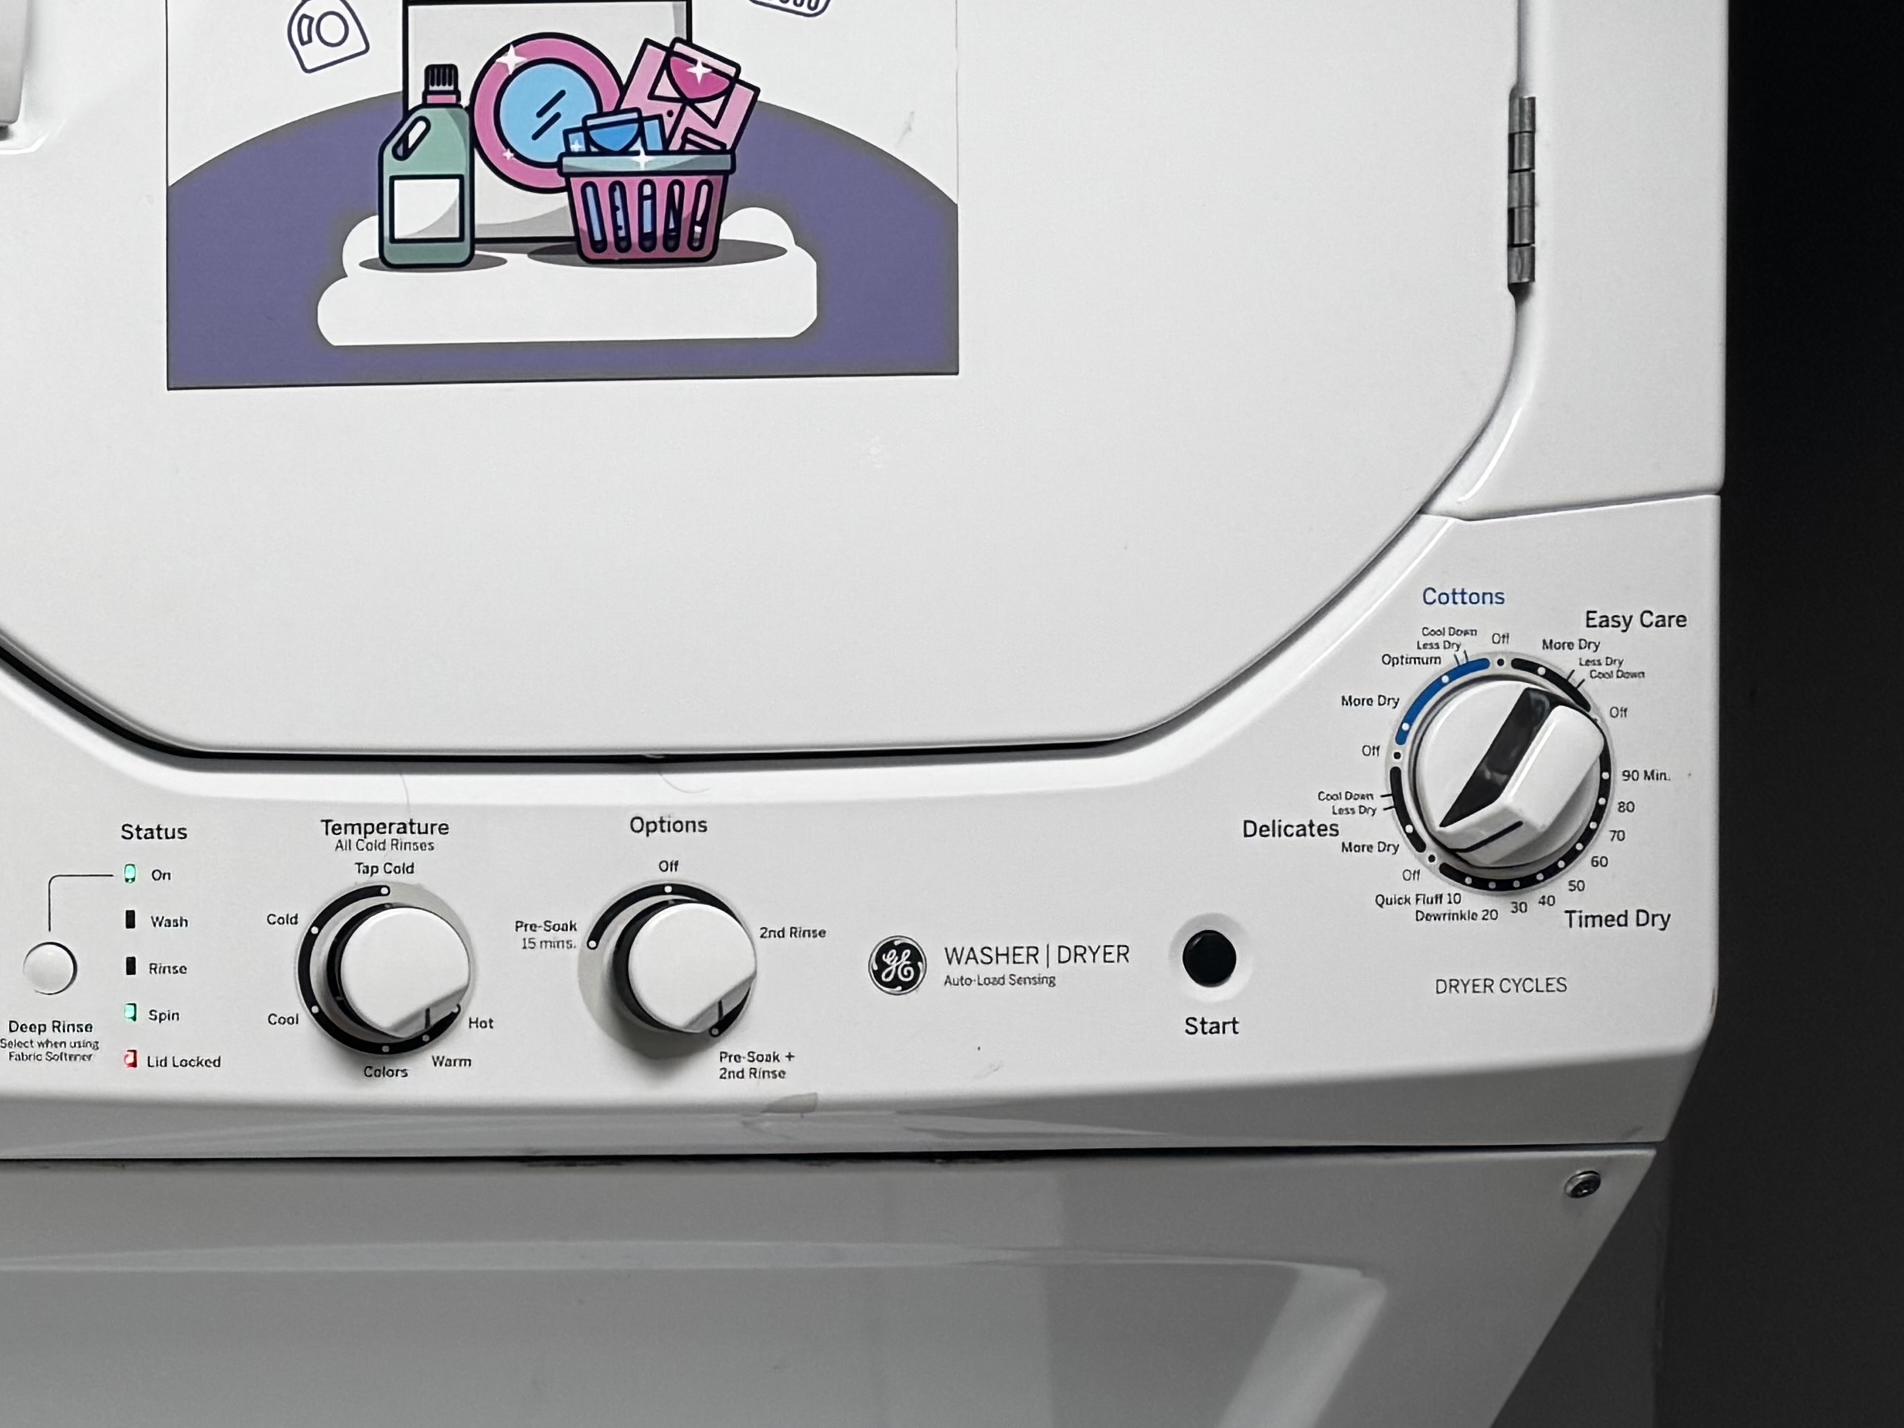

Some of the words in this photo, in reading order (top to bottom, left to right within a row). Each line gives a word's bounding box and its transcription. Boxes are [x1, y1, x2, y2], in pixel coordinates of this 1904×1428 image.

[1423, 587, 1505, 605] Cottons
[1586, 610, 1633, 633] Easy
[1640, 610, 1687, 628] Care
[121, 824, 187, 840] Status
[321, 819, 449, 841] Temperature
[630, 816, 707, 837] Options
[1244, 819, 1339, 838] Delicates
[1609, 830, 1625, 841] 70
[152, 869, 171, 881] On
[355, 862, 379, 877] Tap
[383, 862, 414, 874] Cold
[1568, 880, 1585, 892] 50
[1510, 901, 1527, 913] 30
[1538, 895, 1555, 906] 40
[1564, 909, 1628, 928] Timed
[1636, 909, 1671, 931] Dry
[944, 946, 1039, 965] WASHER
[1058, 945, 1129, 964] DRYER
[944, 974, 1005, 986] Auto-Load
[1009, 974, 1056, 987] Sensing
[1436, 978, 1494, 994] DRYER
[1500, 977, 1567, 993] CYCLES
[149, 1009, 179, 1023] Spin
[1185, 1017, 1239, 1035] Start
[148, 1056, 167, 1067] Lid
[172, 1056, 221, 1068] Locked
